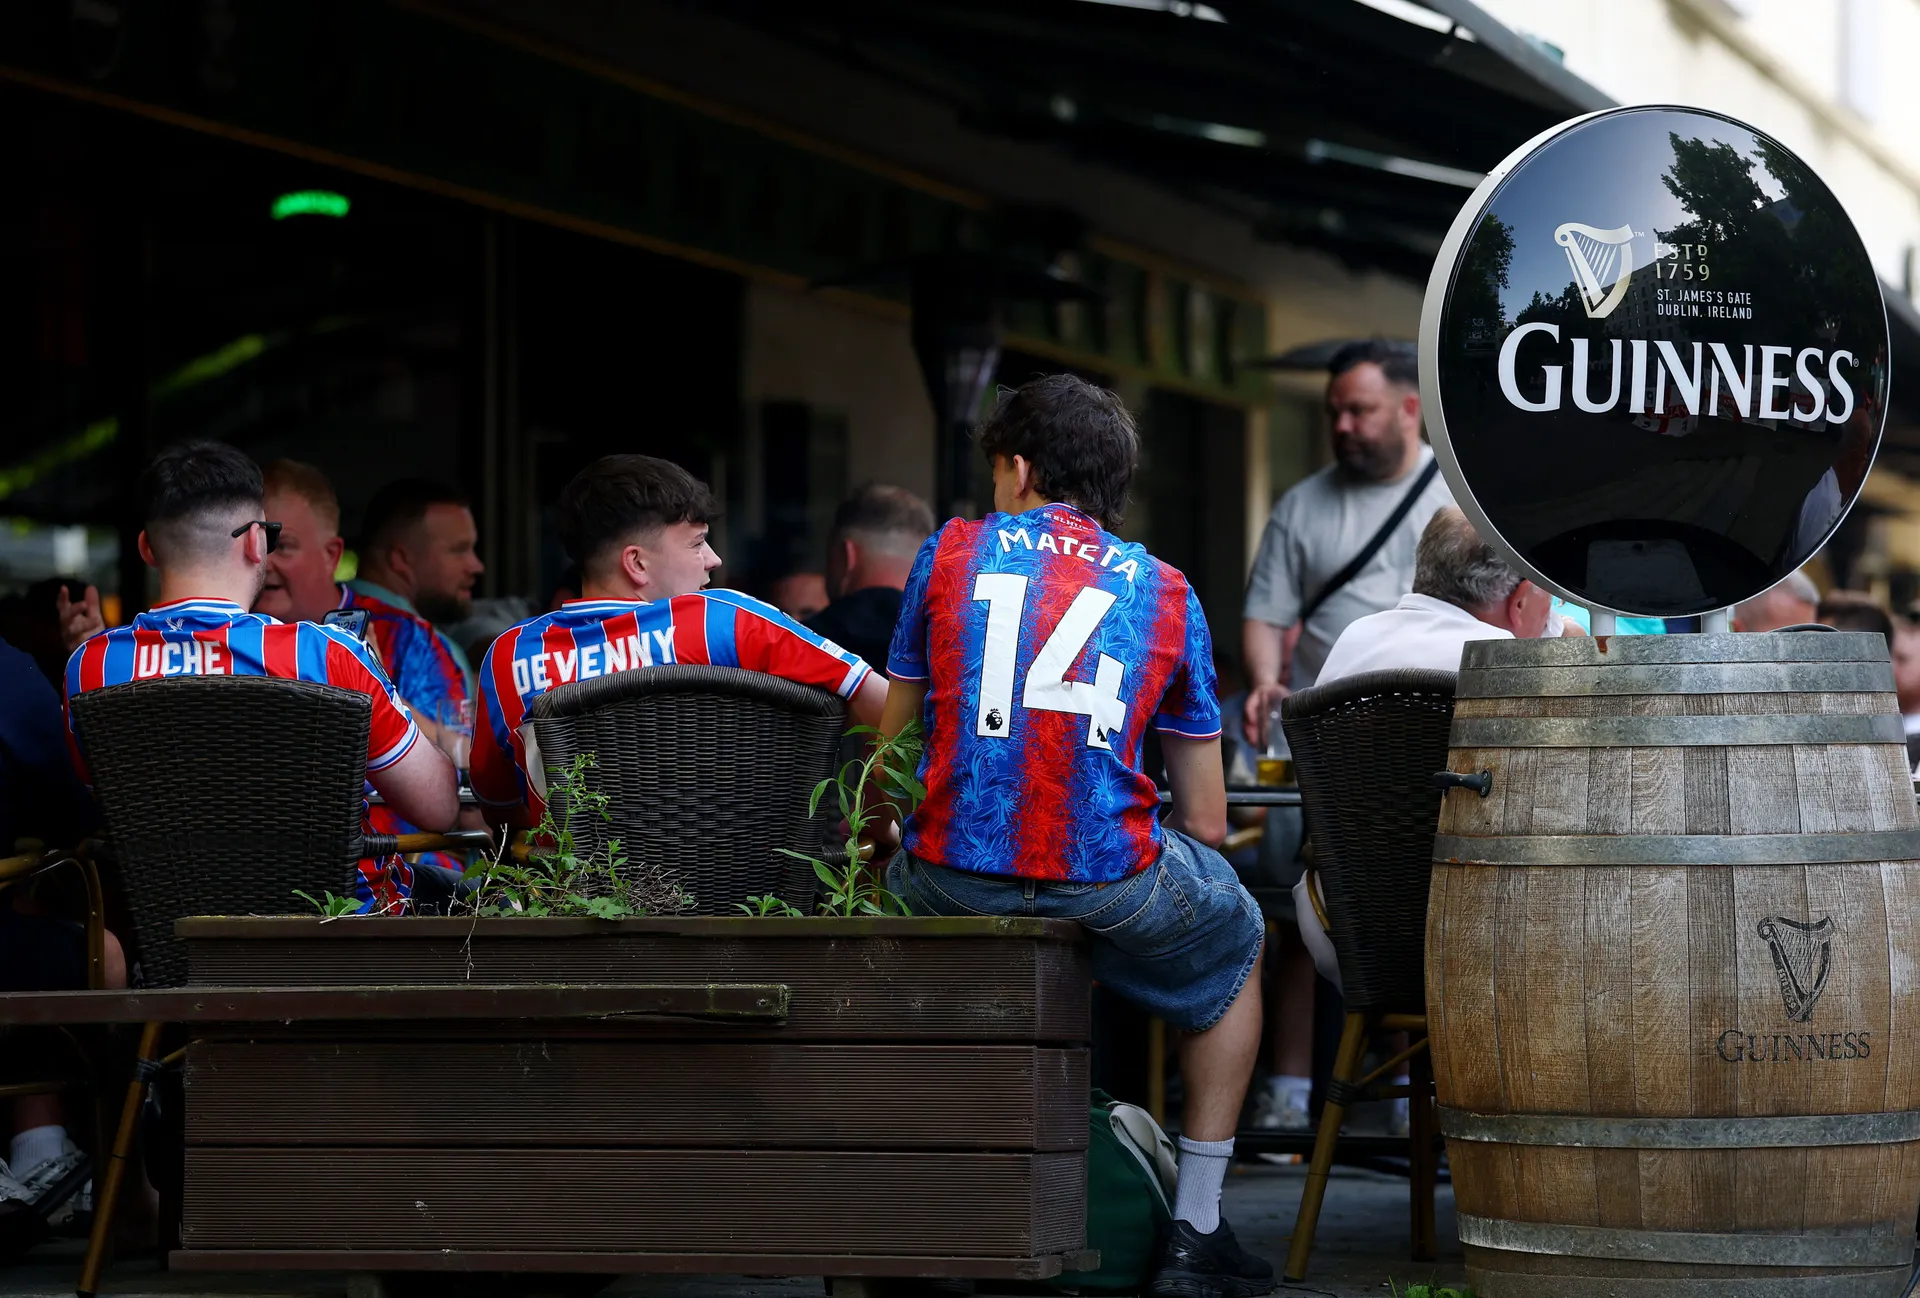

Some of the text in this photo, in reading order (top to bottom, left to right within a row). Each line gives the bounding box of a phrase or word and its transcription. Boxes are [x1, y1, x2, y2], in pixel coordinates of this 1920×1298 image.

[1655, 262, 1710, 281] 1759
[1656, 288, 1752, 305] ST. JAMES'S GATE
[1707, 305, 1753, 319] IRELAND
[1498, 321, 1854, 425] GUINNESS
[997, 527, 1139, 584] MATETA
[137, 640, 225, 678] UCHE
[511, 625, 677, 696] DEVENNY
[972, 572, 1127, 750] 14
[1716, 1029, 1871, 1063] GUINNESS
